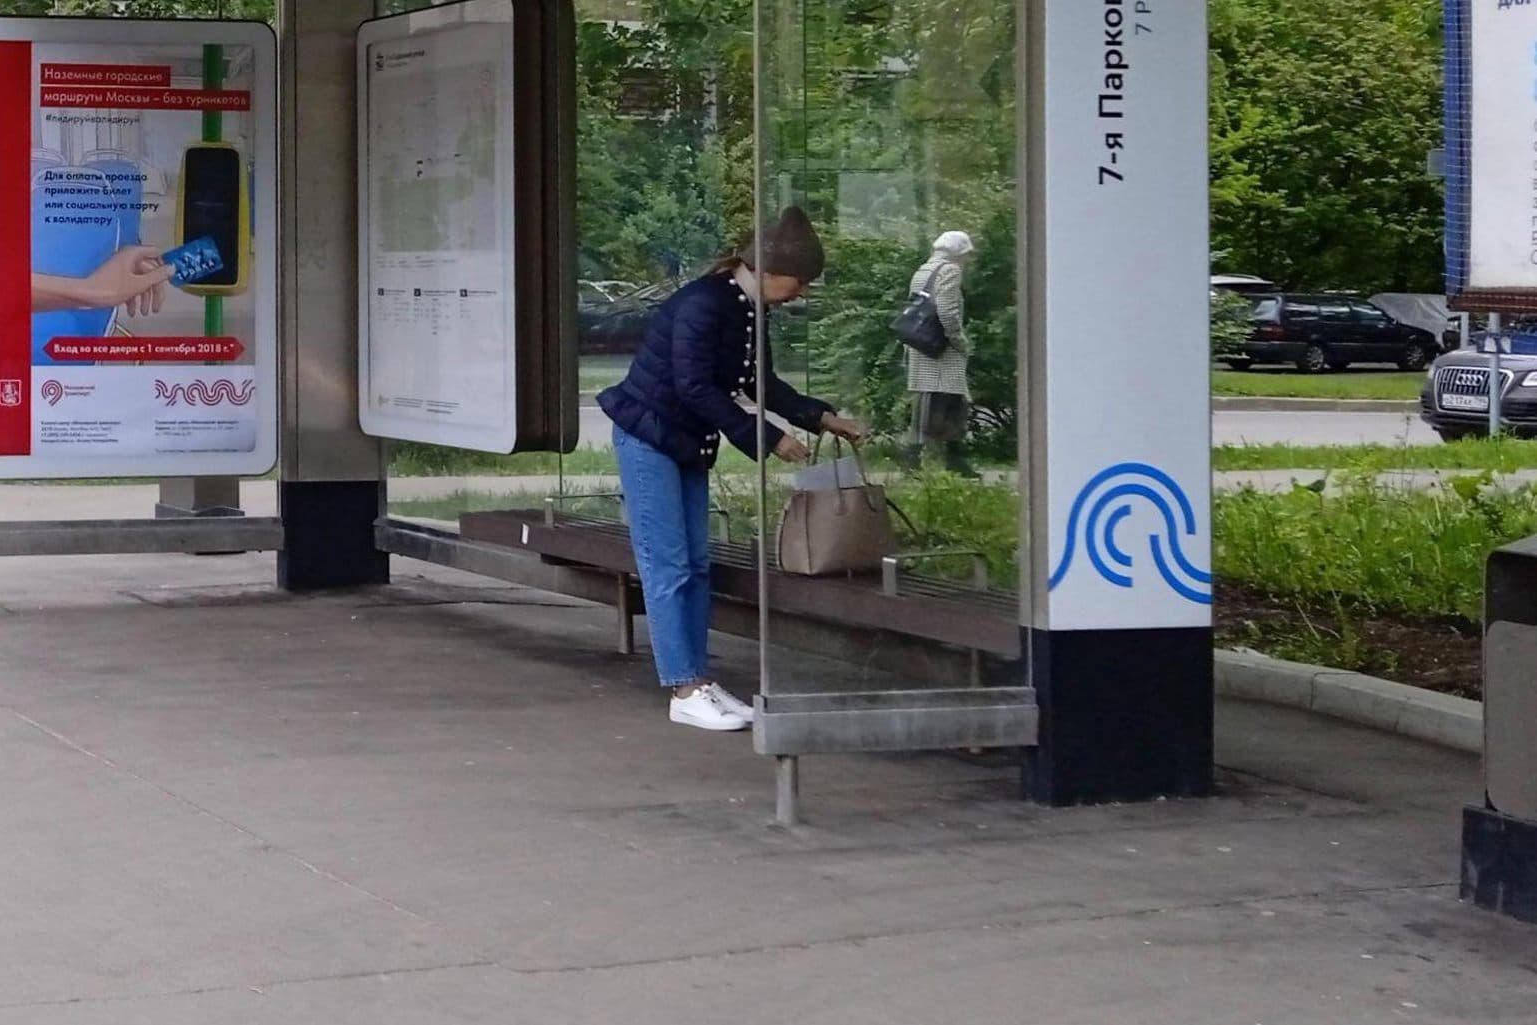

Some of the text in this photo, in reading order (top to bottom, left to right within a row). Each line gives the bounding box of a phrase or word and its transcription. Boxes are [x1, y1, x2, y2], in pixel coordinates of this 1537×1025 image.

[1134, 23, 1153, 35] 7
[44, 68, 164, 83] Наземные городские
[44, 92, 103, 105] маршруты
[106, 92, 150, 104] Москвы
[163, 92, 183, 105] без
[186, 95, 247, 109] турникетов
[1098, 131, 1123, 185] 7-я
[44, 171, 148, 183] Для оплаты проезда
[44, 184, 132, 197] приложите билет
[44, 201, 160, 213] или социальную карту
[53, 215, 113, 227] валидатору
[54, 344, 78, 355] Вход
[80, 345, 91, 353] во
[93, 345, 109, 353] все
[110, 345, 138, 356] двери
[154, 343, 196, 356] сентября
[197, 343, 222, 353] 2018
